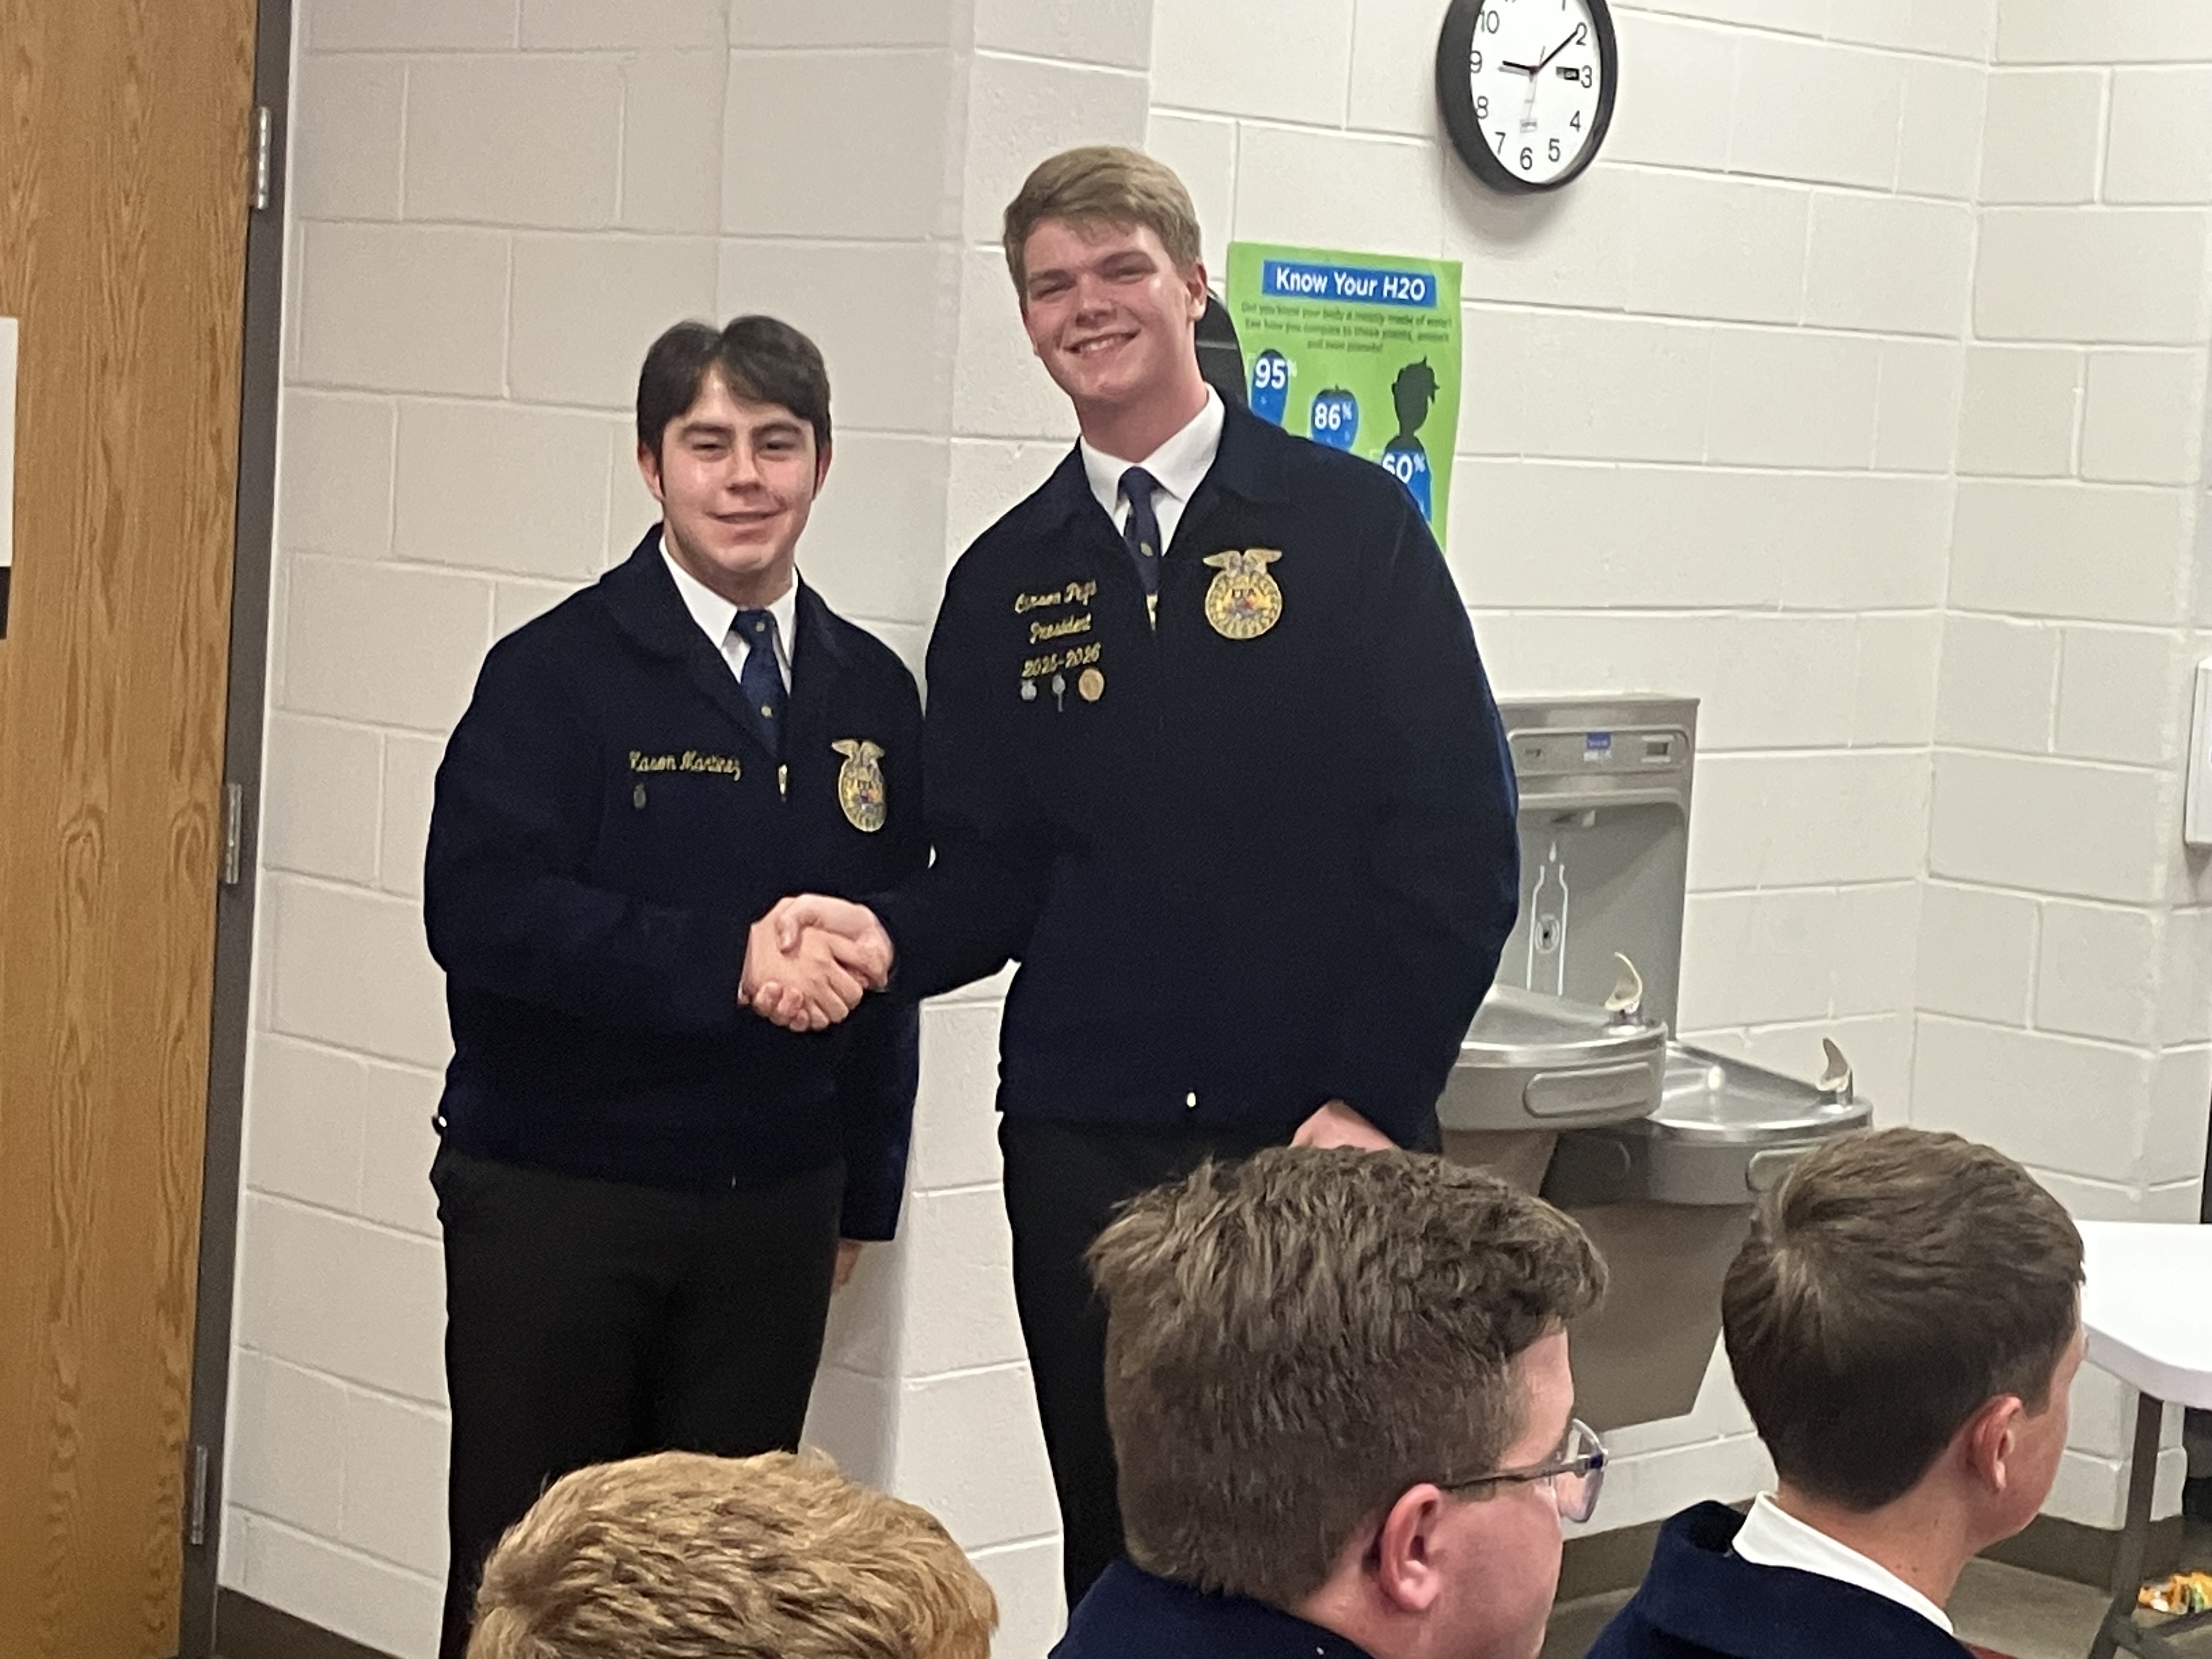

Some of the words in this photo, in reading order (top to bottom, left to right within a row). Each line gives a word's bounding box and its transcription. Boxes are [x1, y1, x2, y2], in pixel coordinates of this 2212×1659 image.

[1480, 10, 1500, 34] 10
[1575, 22, 1588, 46] 2
[1470, 50, 1482, 74] 9
[1580, 65, 1592, 88] 3
[1476, 95, 1489, 119] 8
[1570, 110, 1582, 133] 4
[1495, 131, 1506, 155] 7
[1548, 138, 1561, 162] 5
[1520, 146, 1533, 170] 6
[1276, 266, 1328, 294] Know
[1333, 271, 1378, 297] Your
[1382, 276, 1426, 301] H2O
[1314, 400, 1353, 431] 86%
